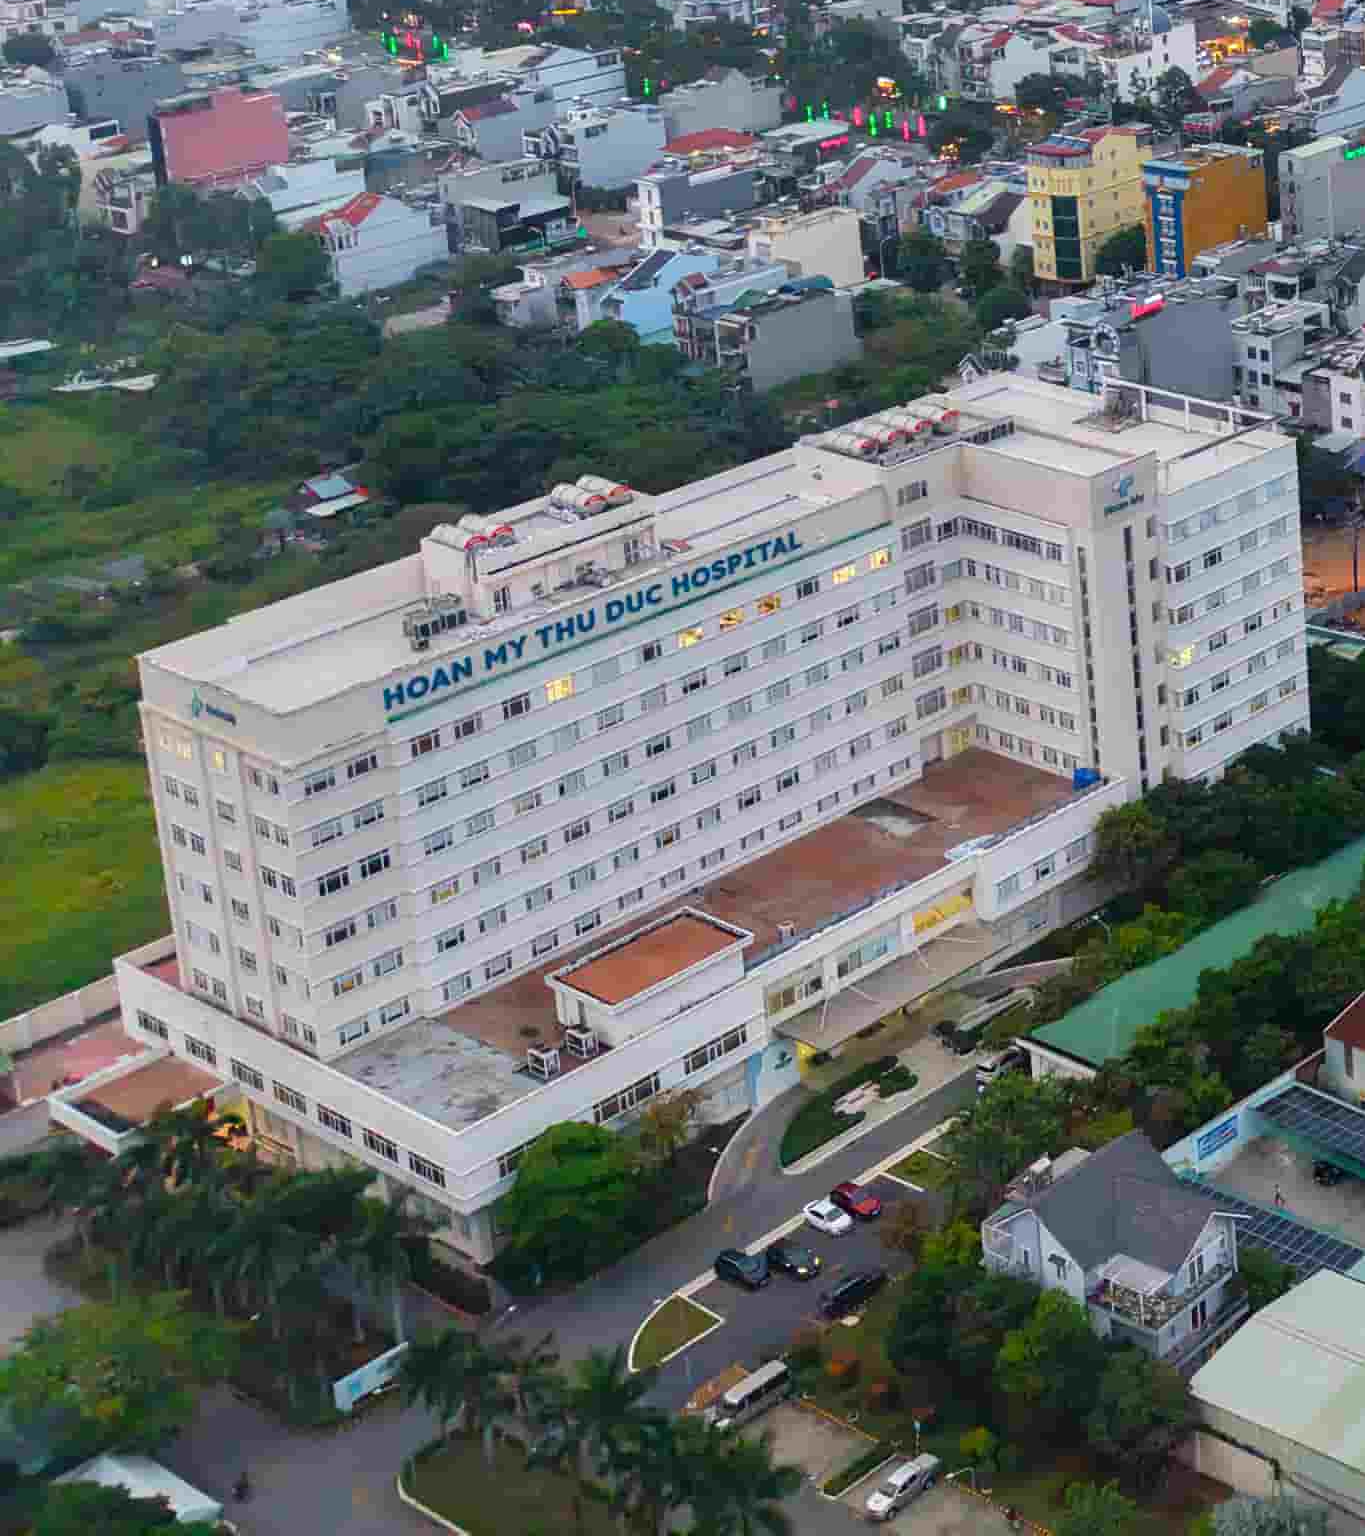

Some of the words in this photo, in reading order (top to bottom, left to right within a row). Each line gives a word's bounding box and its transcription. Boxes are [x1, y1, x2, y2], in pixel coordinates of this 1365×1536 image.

[383, 656, 473, 711] HOAN
[484, 634, 528, 671] MY
[534, 609, 596, 649] THU
[605, 583, 664, 624] DUC
[672, 531, 803, 598] HOSPITAL
